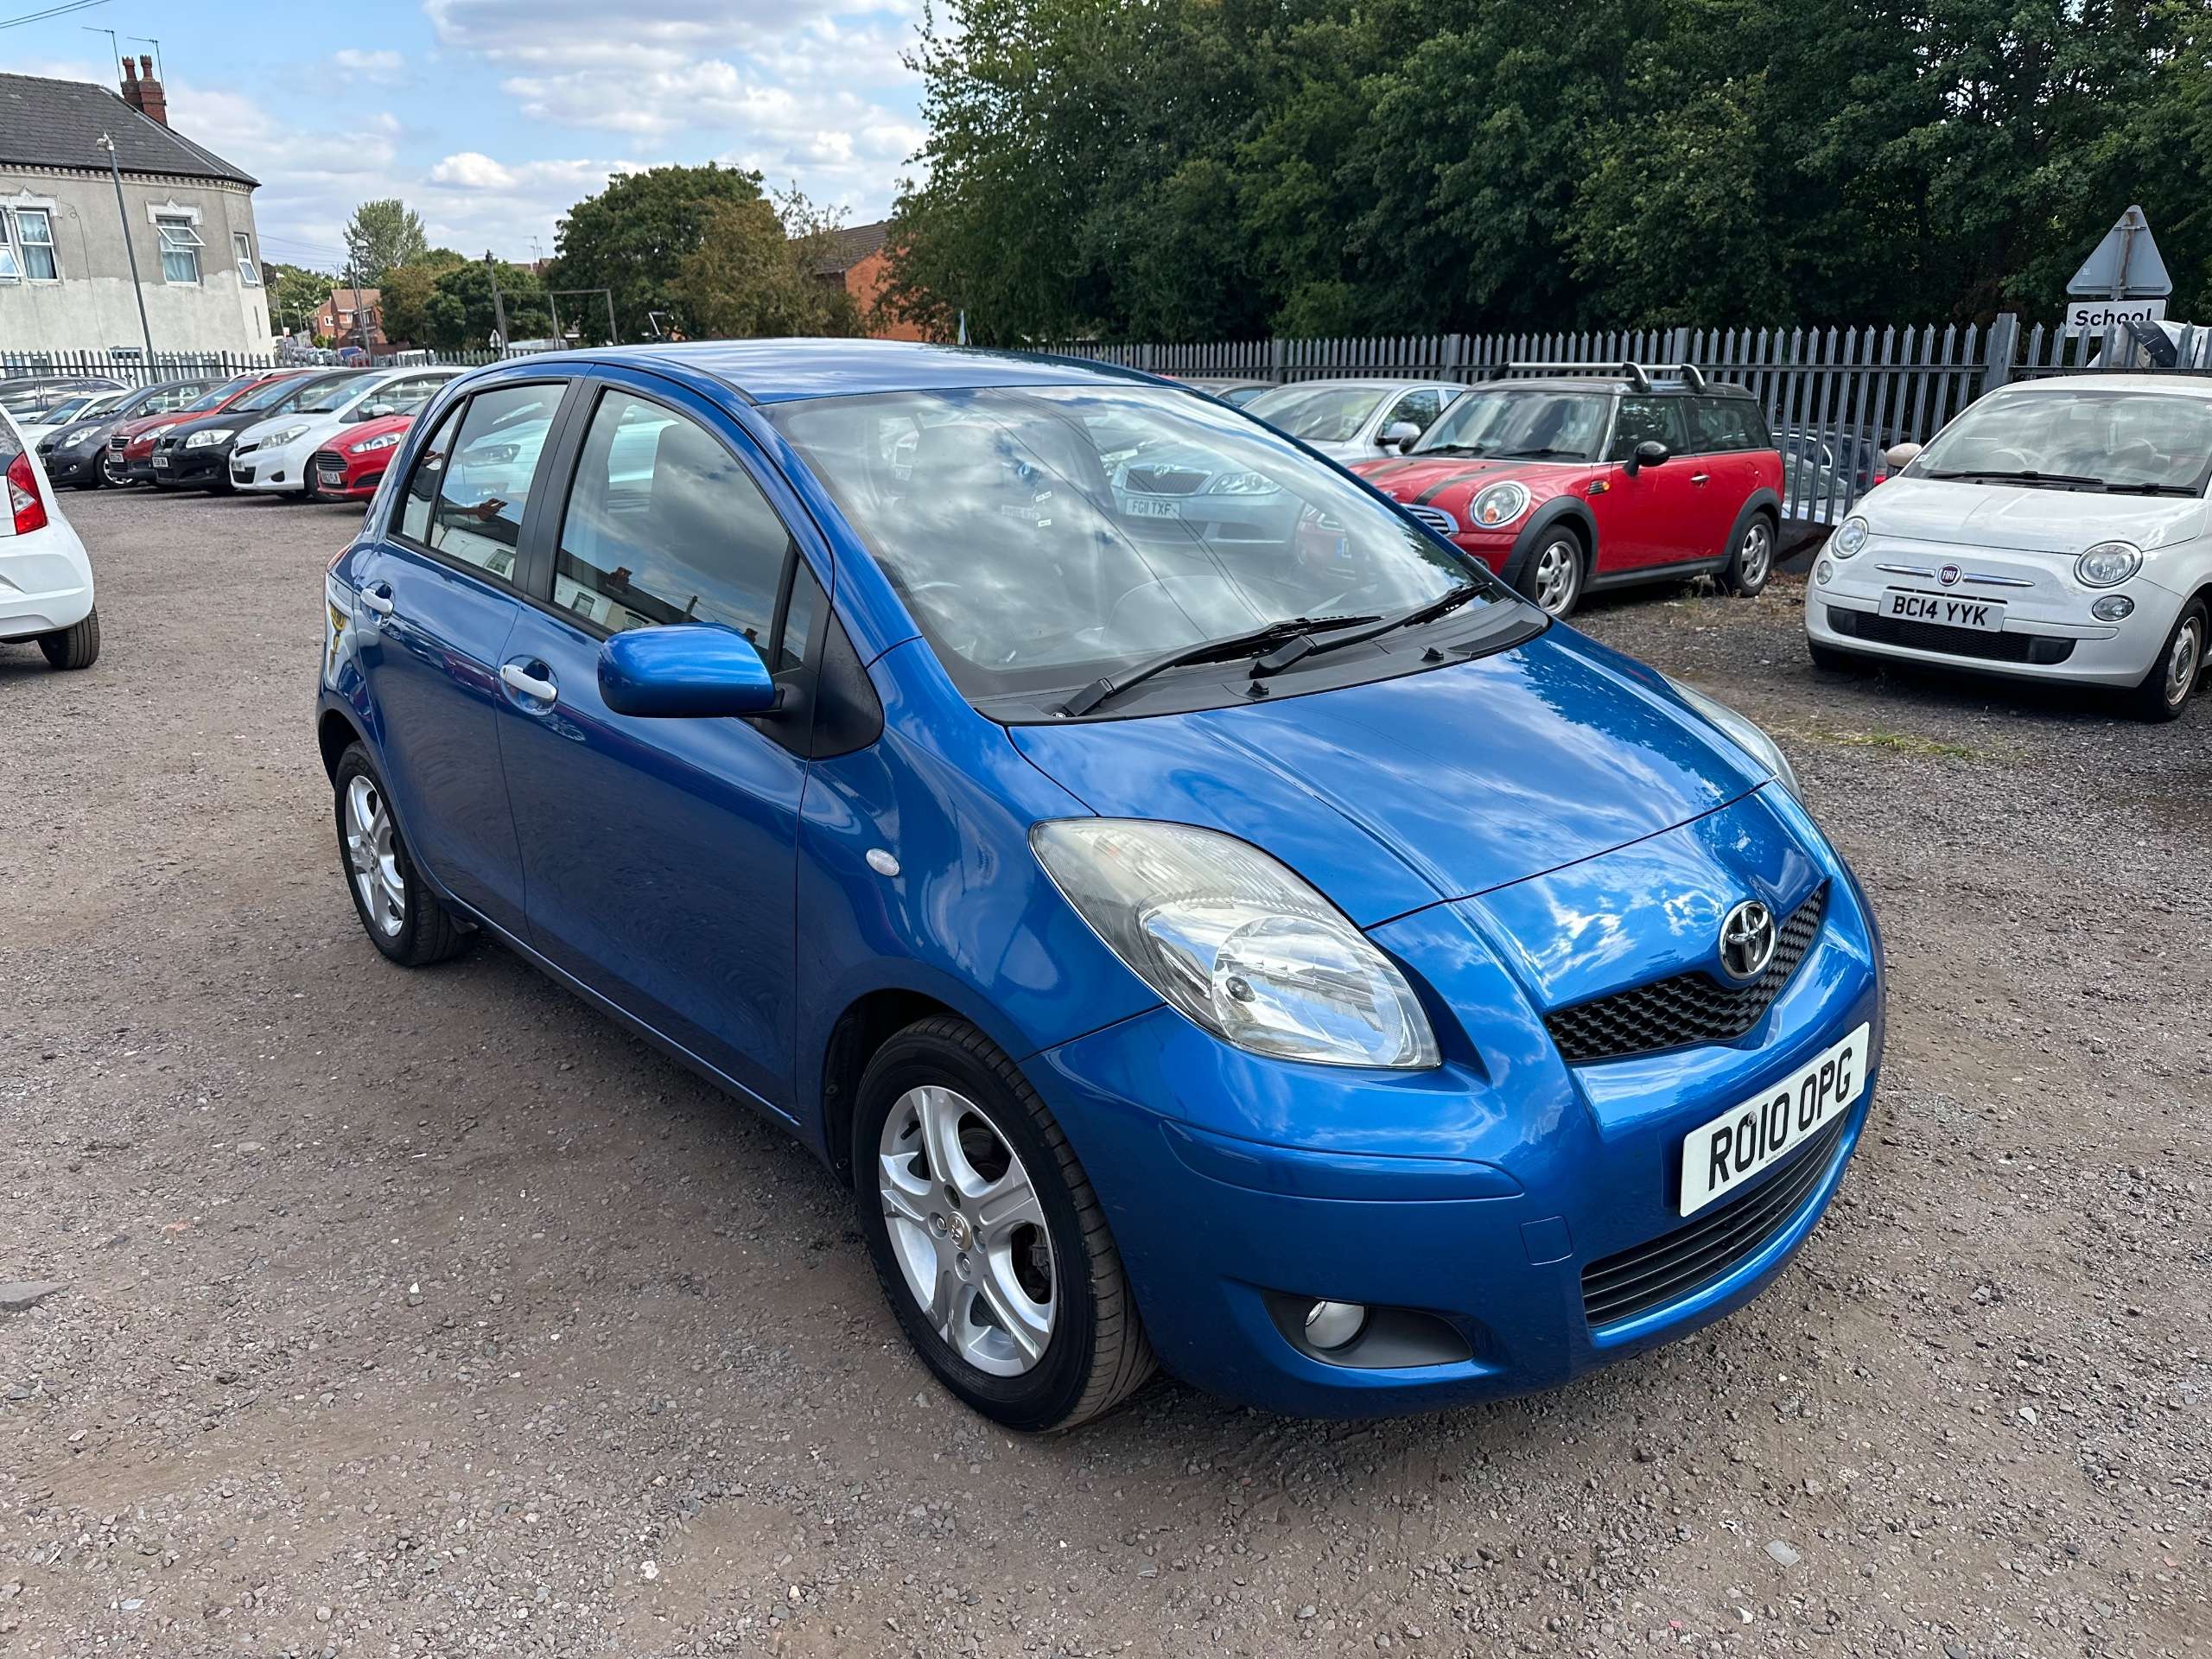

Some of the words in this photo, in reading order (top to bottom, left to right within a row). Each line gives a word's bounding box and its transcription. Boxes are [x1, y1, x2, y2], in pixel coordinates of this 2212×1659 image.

[2074, 308, 2152, 327] School
[1132, 500, 1149, 514] FG11
[1152, 501, 1172, 516] TXF
[1942, 569, 1956, 581] FIAT
[1891, 594, 1938, 620] BC14
[1947, 602, 1989, 626] YYK
[1708, 1091, 1790, 1192] RO10
[1798, 1046, 1853, 1132] OPG
